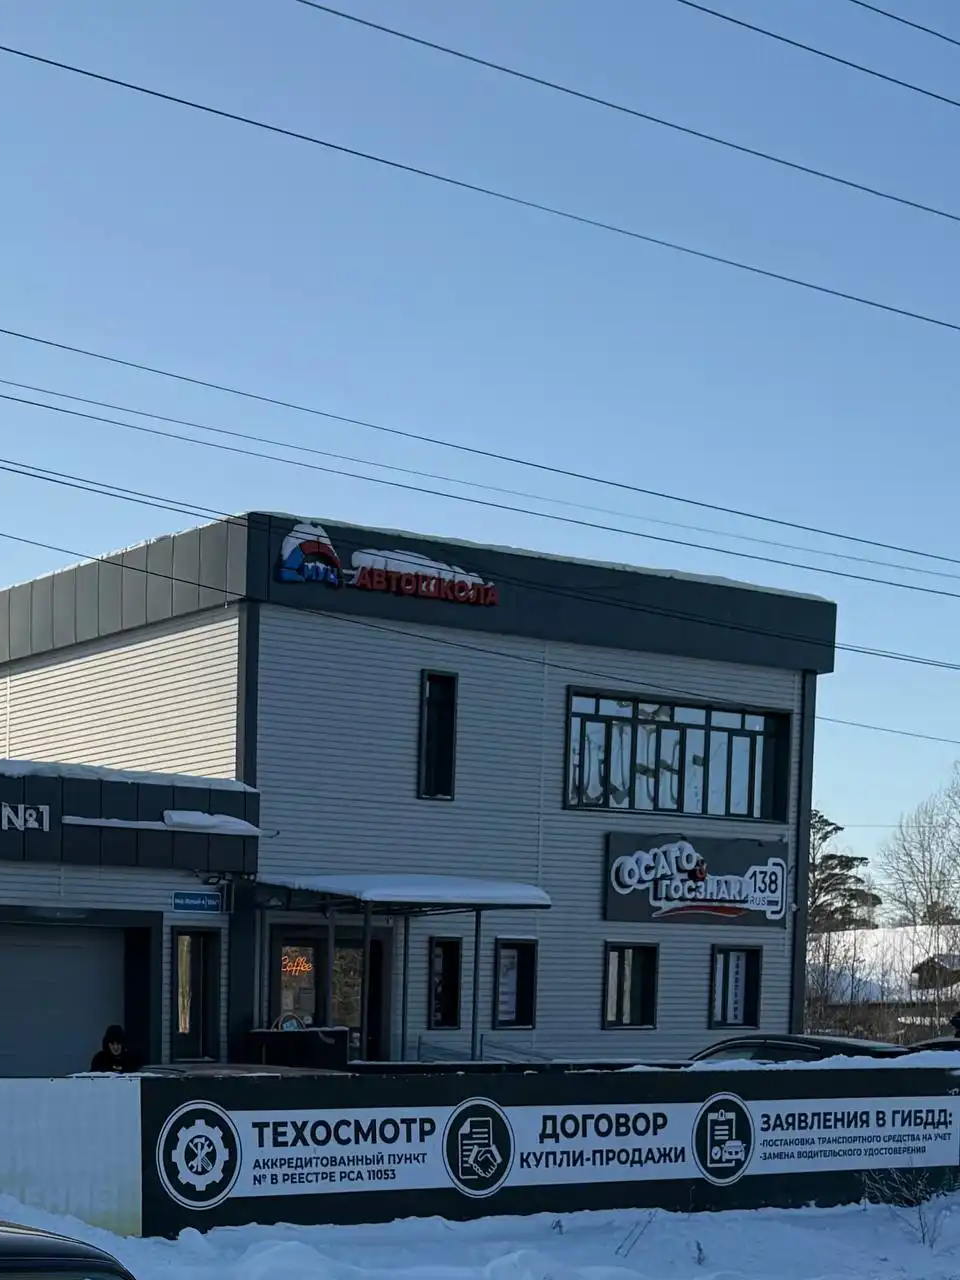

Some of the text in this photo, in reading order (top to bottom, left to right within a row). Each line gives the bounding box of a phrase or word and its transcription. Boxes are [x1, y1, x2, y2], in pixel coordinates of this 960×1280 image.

[356, 565, 500, 606] АВТОШКОЛА
[1, 801, 50, 832] №1
[619, 842, 697, 887] ОСАГО
[749, 870, 779, 894] 138
[749, 895, 768, 906] RUS
[539, 1112, 668, 1144] ДОГОВОР
[760, 1108, 953, 1132] ЗАЯВЛЕНИЯ В ГИБДД:
[251, 1117, 437, 1148] ТЕХОСМОТР
[818, 1133, 881, 1145] ТРАНСПОРТНОГО
[883, 1132, 920, 1143] СРЕДСТВА
[922, 1132, 932, 1142] НА
[252, 1152, 428, 1171] АККРЕДИТОВАННЫЙ ПУНКТ
[519, 1146, 686, 1169] КУПЛИ-ПРОДАЖИ
[797, 1147, 862, 1160] ВОДИТЕЛЬСКОГО
[863, 1146, 926, 1158] УДОСТОВЕРЕНИЯ
[271, 1173, 279, 1185] В
[282, 1171, 337, 1185] РЕЕСТРЕ
[339, 1170, 365, 1183] РСА
[367, 1168, 397, 1182] 11053
